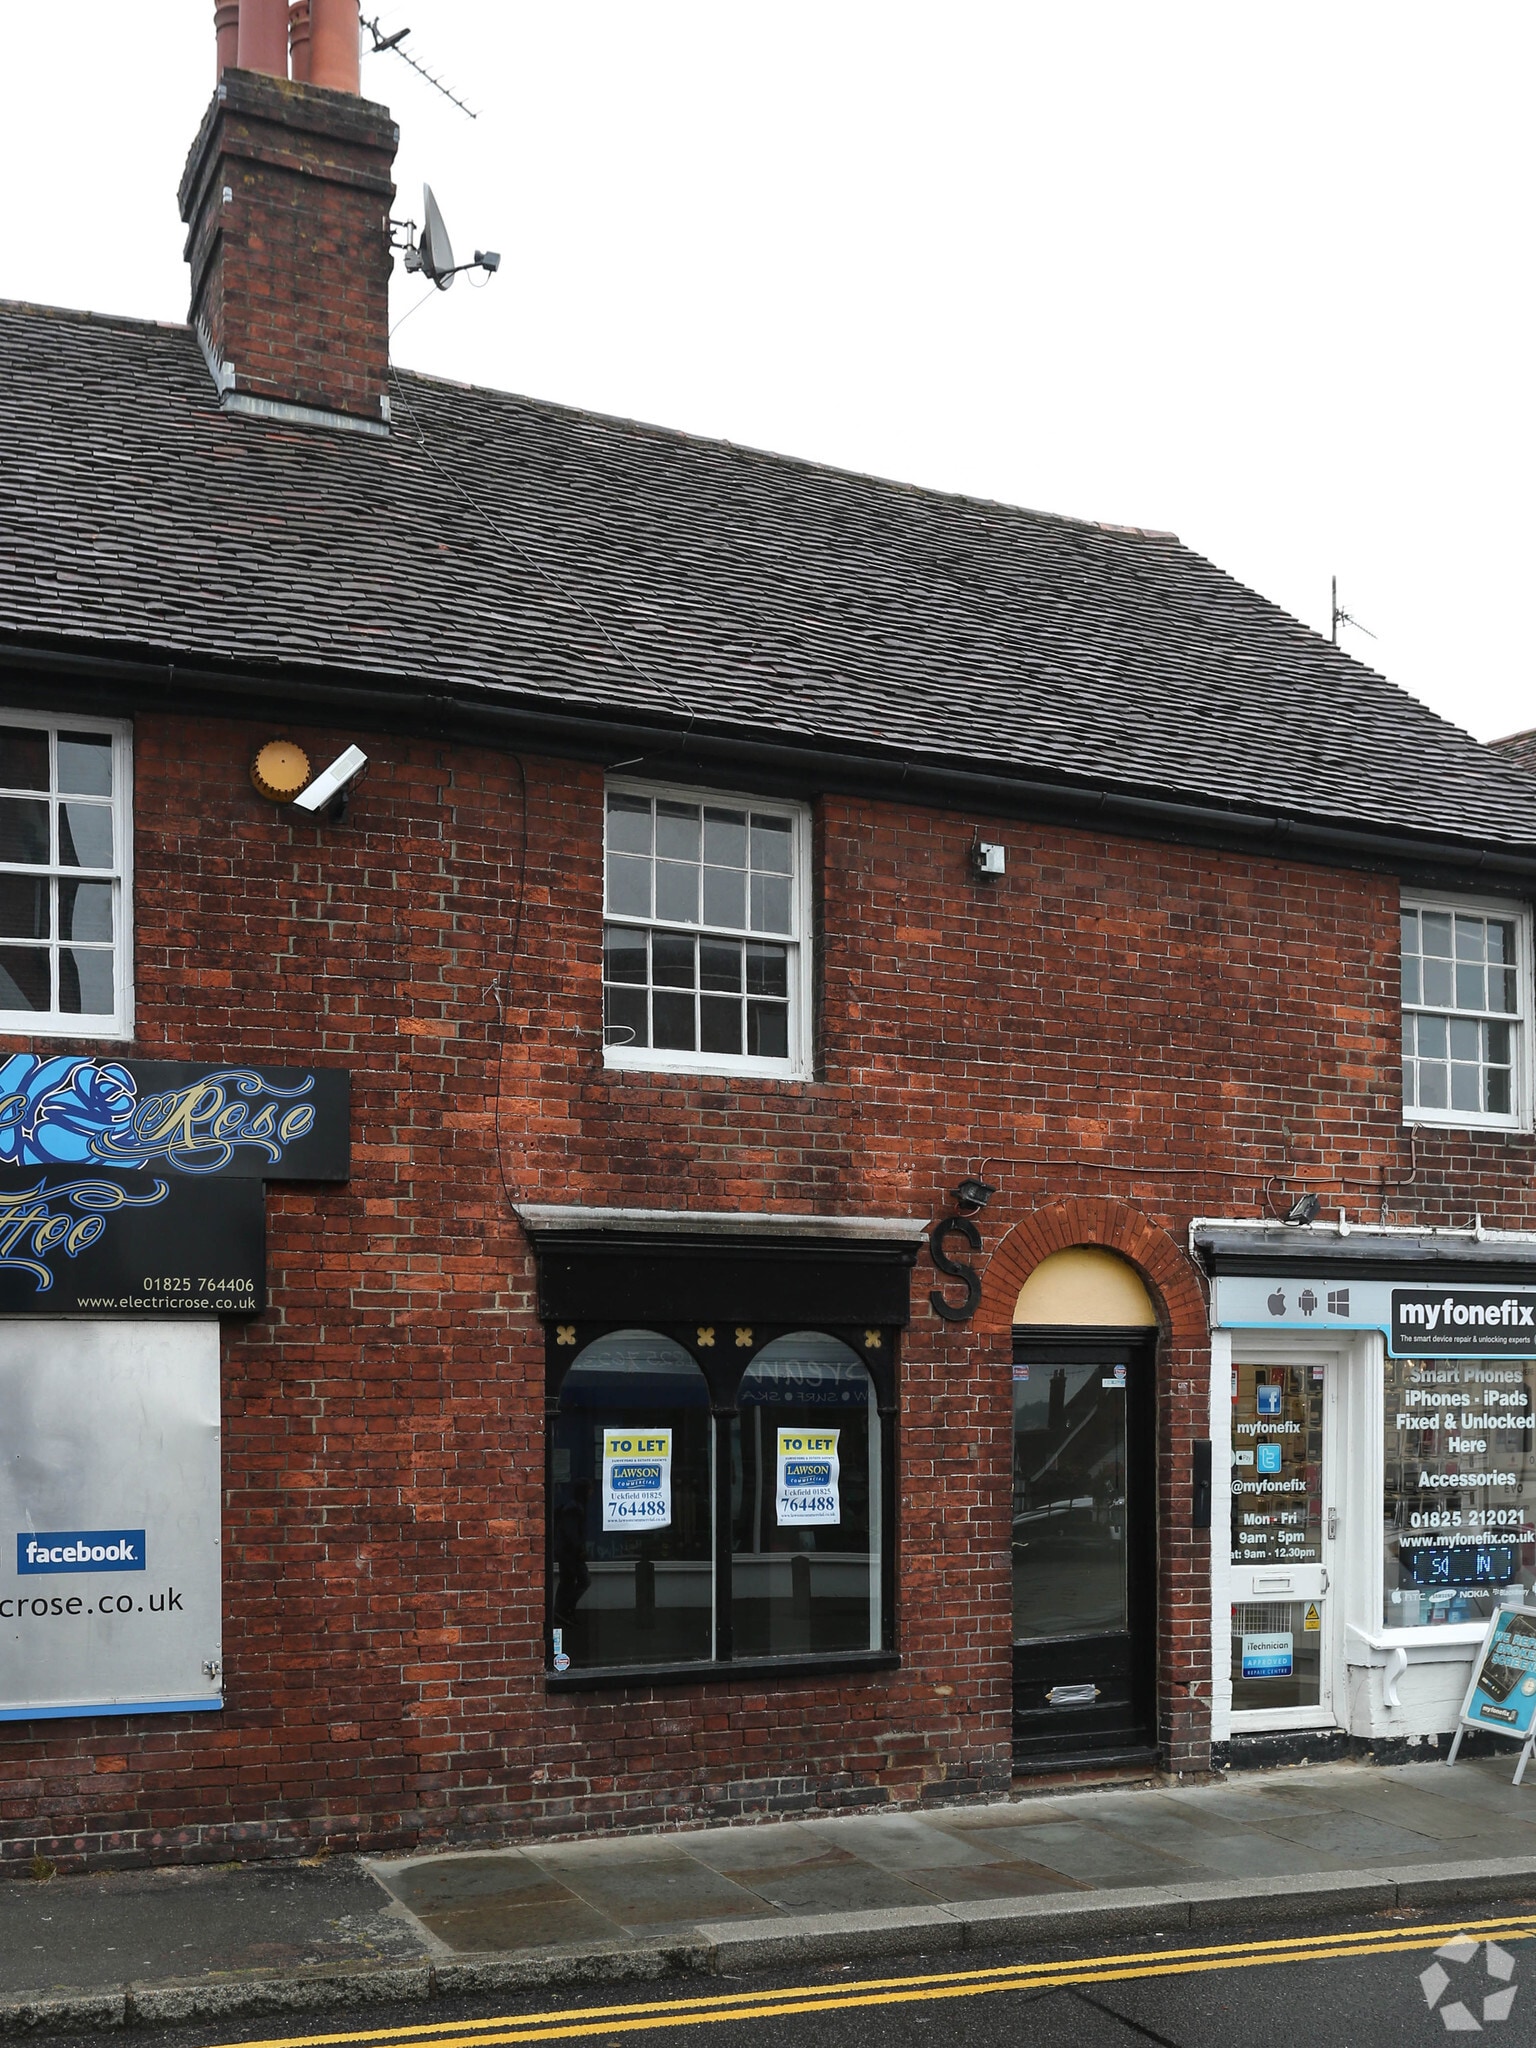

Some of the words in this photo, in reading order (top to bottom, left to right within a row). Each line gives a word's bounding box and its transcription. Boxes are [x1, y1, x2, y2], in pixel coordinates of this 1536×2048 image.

[110, 1070, 315, 1168] Rose
[143, 1277, 192, 1291] 01825
[197, 1278, 255, 1292] 764406
[77, 1295, 256, 1309] www.electricrose.co.uk
[1399, 1298, 1535, 1330] myfonefix
[1399, 1334, 1413, 1343] The
[1413, 1335, 1432, 1343] smart
[1432, 1335, 1453, 1343] device
[1453, 1335, 1472, 1344] repair
[1472, 1335, 1478, 1343] &
[1478, 1336, 1508, 1345] unlocking
[1508, 1336, 1531, 1344] experts
[1410, 1367, 1460, 1383] Smart
[1464, 1367, 1523, 1383] Phones
[1405, 1389, 1471, 1407] iPhones
[1483, 1389, 1528, 1406] iPads
[1237, 1420, 1301, 1436] myfonefix
[1396, 1413, 1440, 1430] Fixed
[1444, 1413, 1457, 1430] &
[1461, 1413, 1536, 1429] Unlocked
[610, 1440, 632, 1452] TO
[638, 1440, 666, 1452] LET
[783, 1439, 803, 1451] TO
[807, 1439, 833, 1451] LET
[1448, 1436, 1487, 1453] Here
[614, 1468, 659, 1478] LAWSON
[787, 1465, 830, 1475] LAWSON
[1418, 1469, 1517, 1487] Accessories
[1231, 1478, 1307, 1495] @myfonefix
[611, 1492, 640, 1500] Uckfield
[608, 1500, 666, 1516] 764488
[781, 1496, 834, 1512] 764488
[1243, 1513, 1270, 1526] Mon
[1281, 1512, 1297, 1525] Fri
[1410, 1511, 1462, 1528] 01825
[1468, 1509, 1525, 1526] 212021
[1239, 1532, 1267, 1544] 9am
[1277, 1530, 1305, 1545] 5pm
[1399, 1530, 1535, 1549] www.myfonefix.co.uk
[1244, 1549, 1266, 1559] 9am
[1274, 1547, 1316, 1559] 12.30pm
[1459, 1589, 1490, 1599] NOKIA
[0, 1587, 184, 1618] crose.co.uk
[1247, 1640, 1289, 1651] iTechnician
[1495, 1631, 1511, 1643] WE
[1512, 1634, 1536, 1649] REP
[1247, 1657, 1288, 1666] APPROVED
[1482, 1705, 1510, 1717] myfonefix
